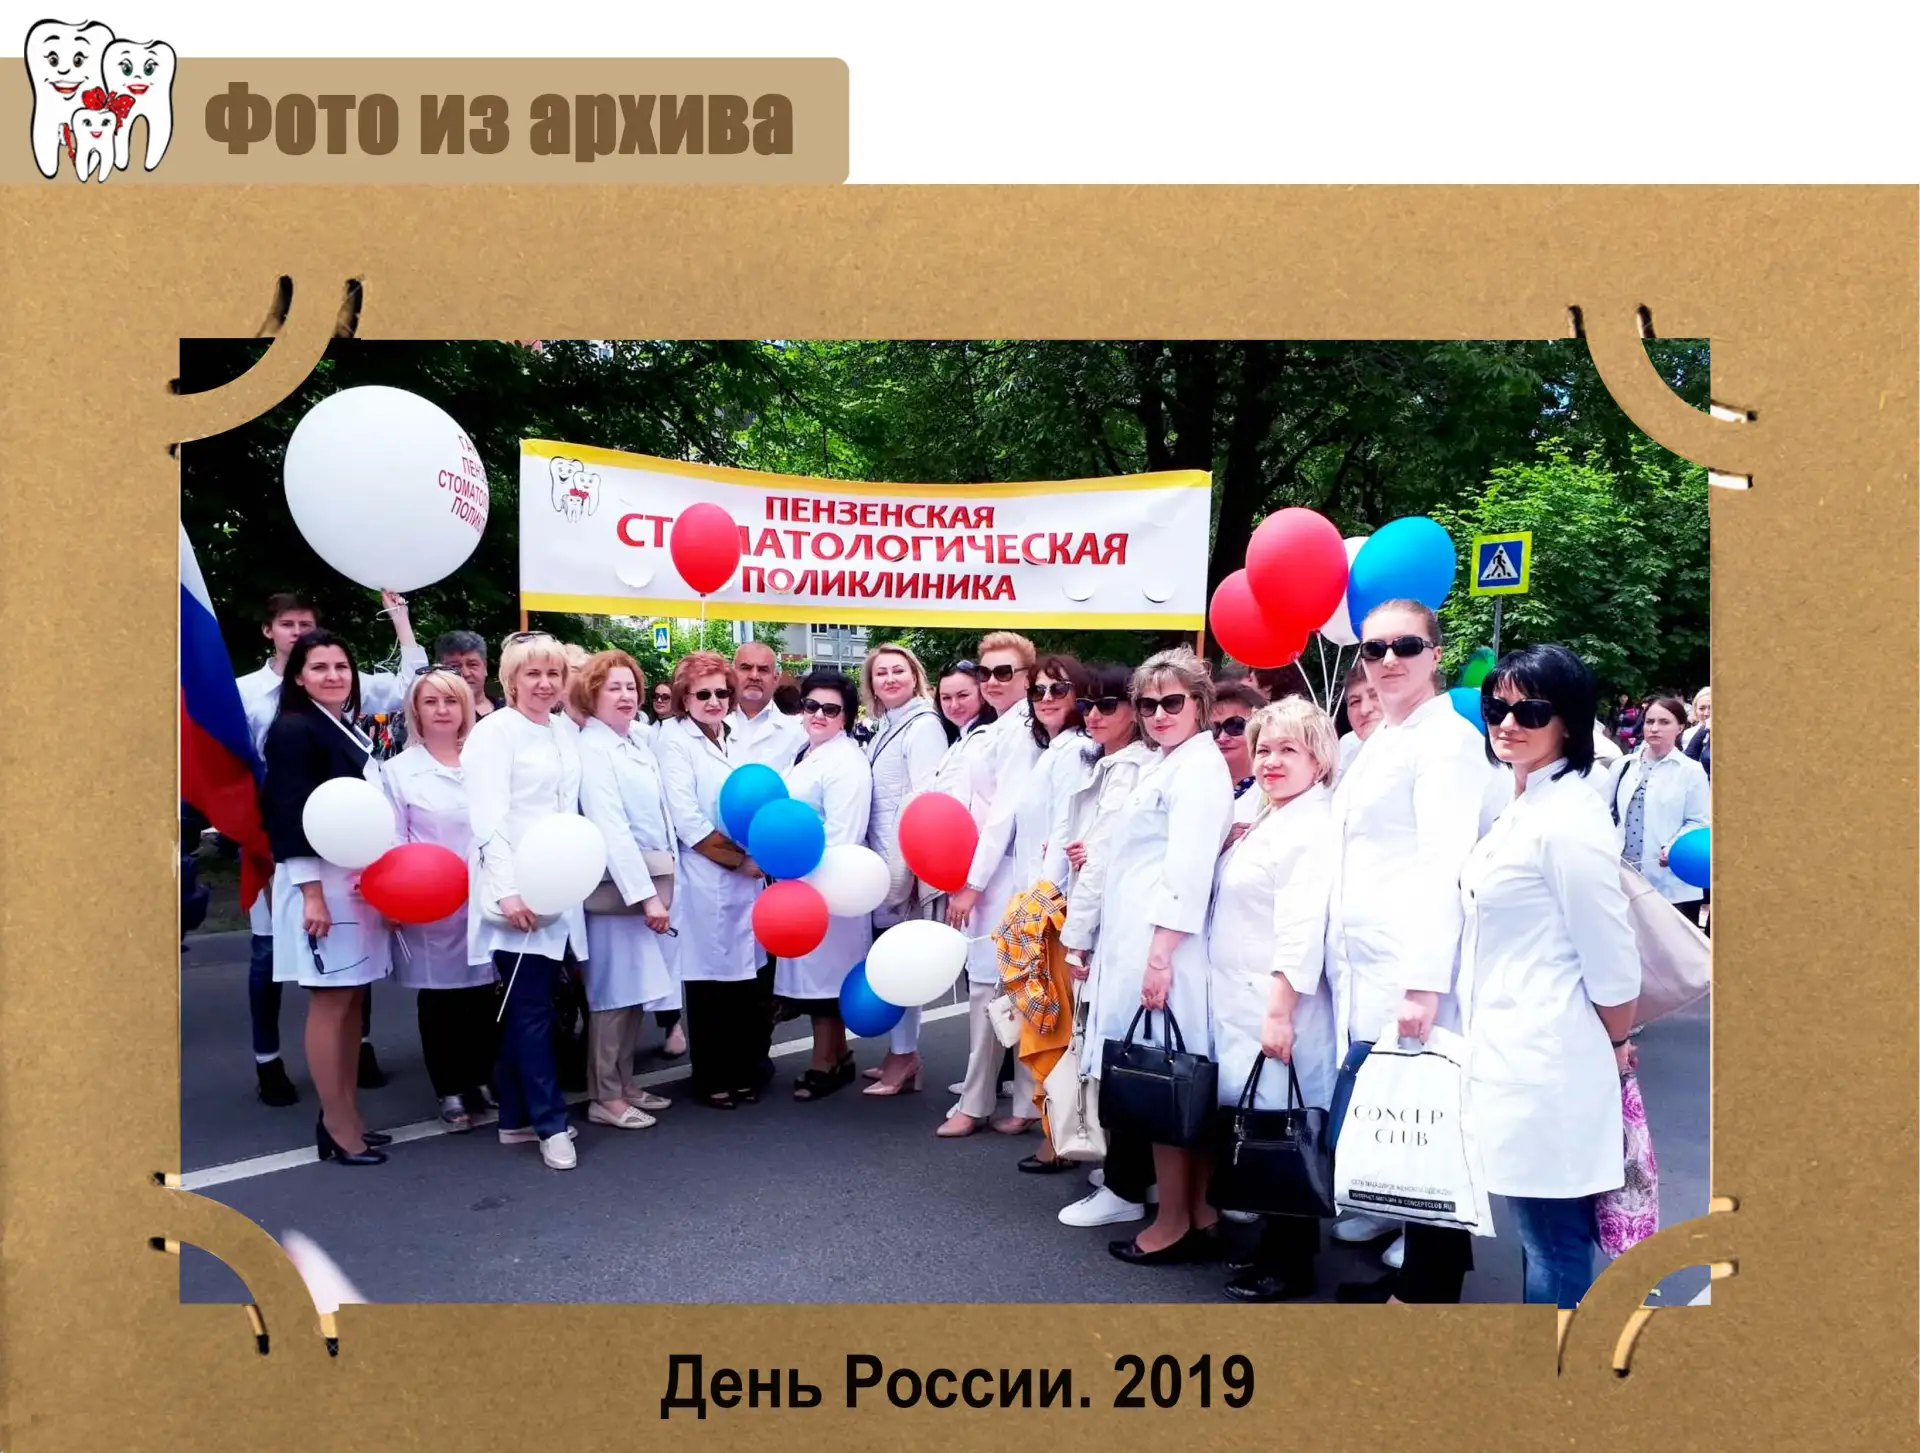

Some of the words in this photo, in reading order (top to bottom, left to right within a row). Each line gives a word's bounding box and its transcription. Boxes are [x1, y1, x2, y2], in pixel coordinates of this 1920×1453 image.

[765, 496, 994, 529] ПЕНЗЕНСКАЯ
[616, 512, 1128, 565] СТАТОЛОГИЧЕСКАЯ
[742, 565, 1016, 601] ПОЛИКЛИНИКА
[1375, 1128, 1428, 1146] CLUB
